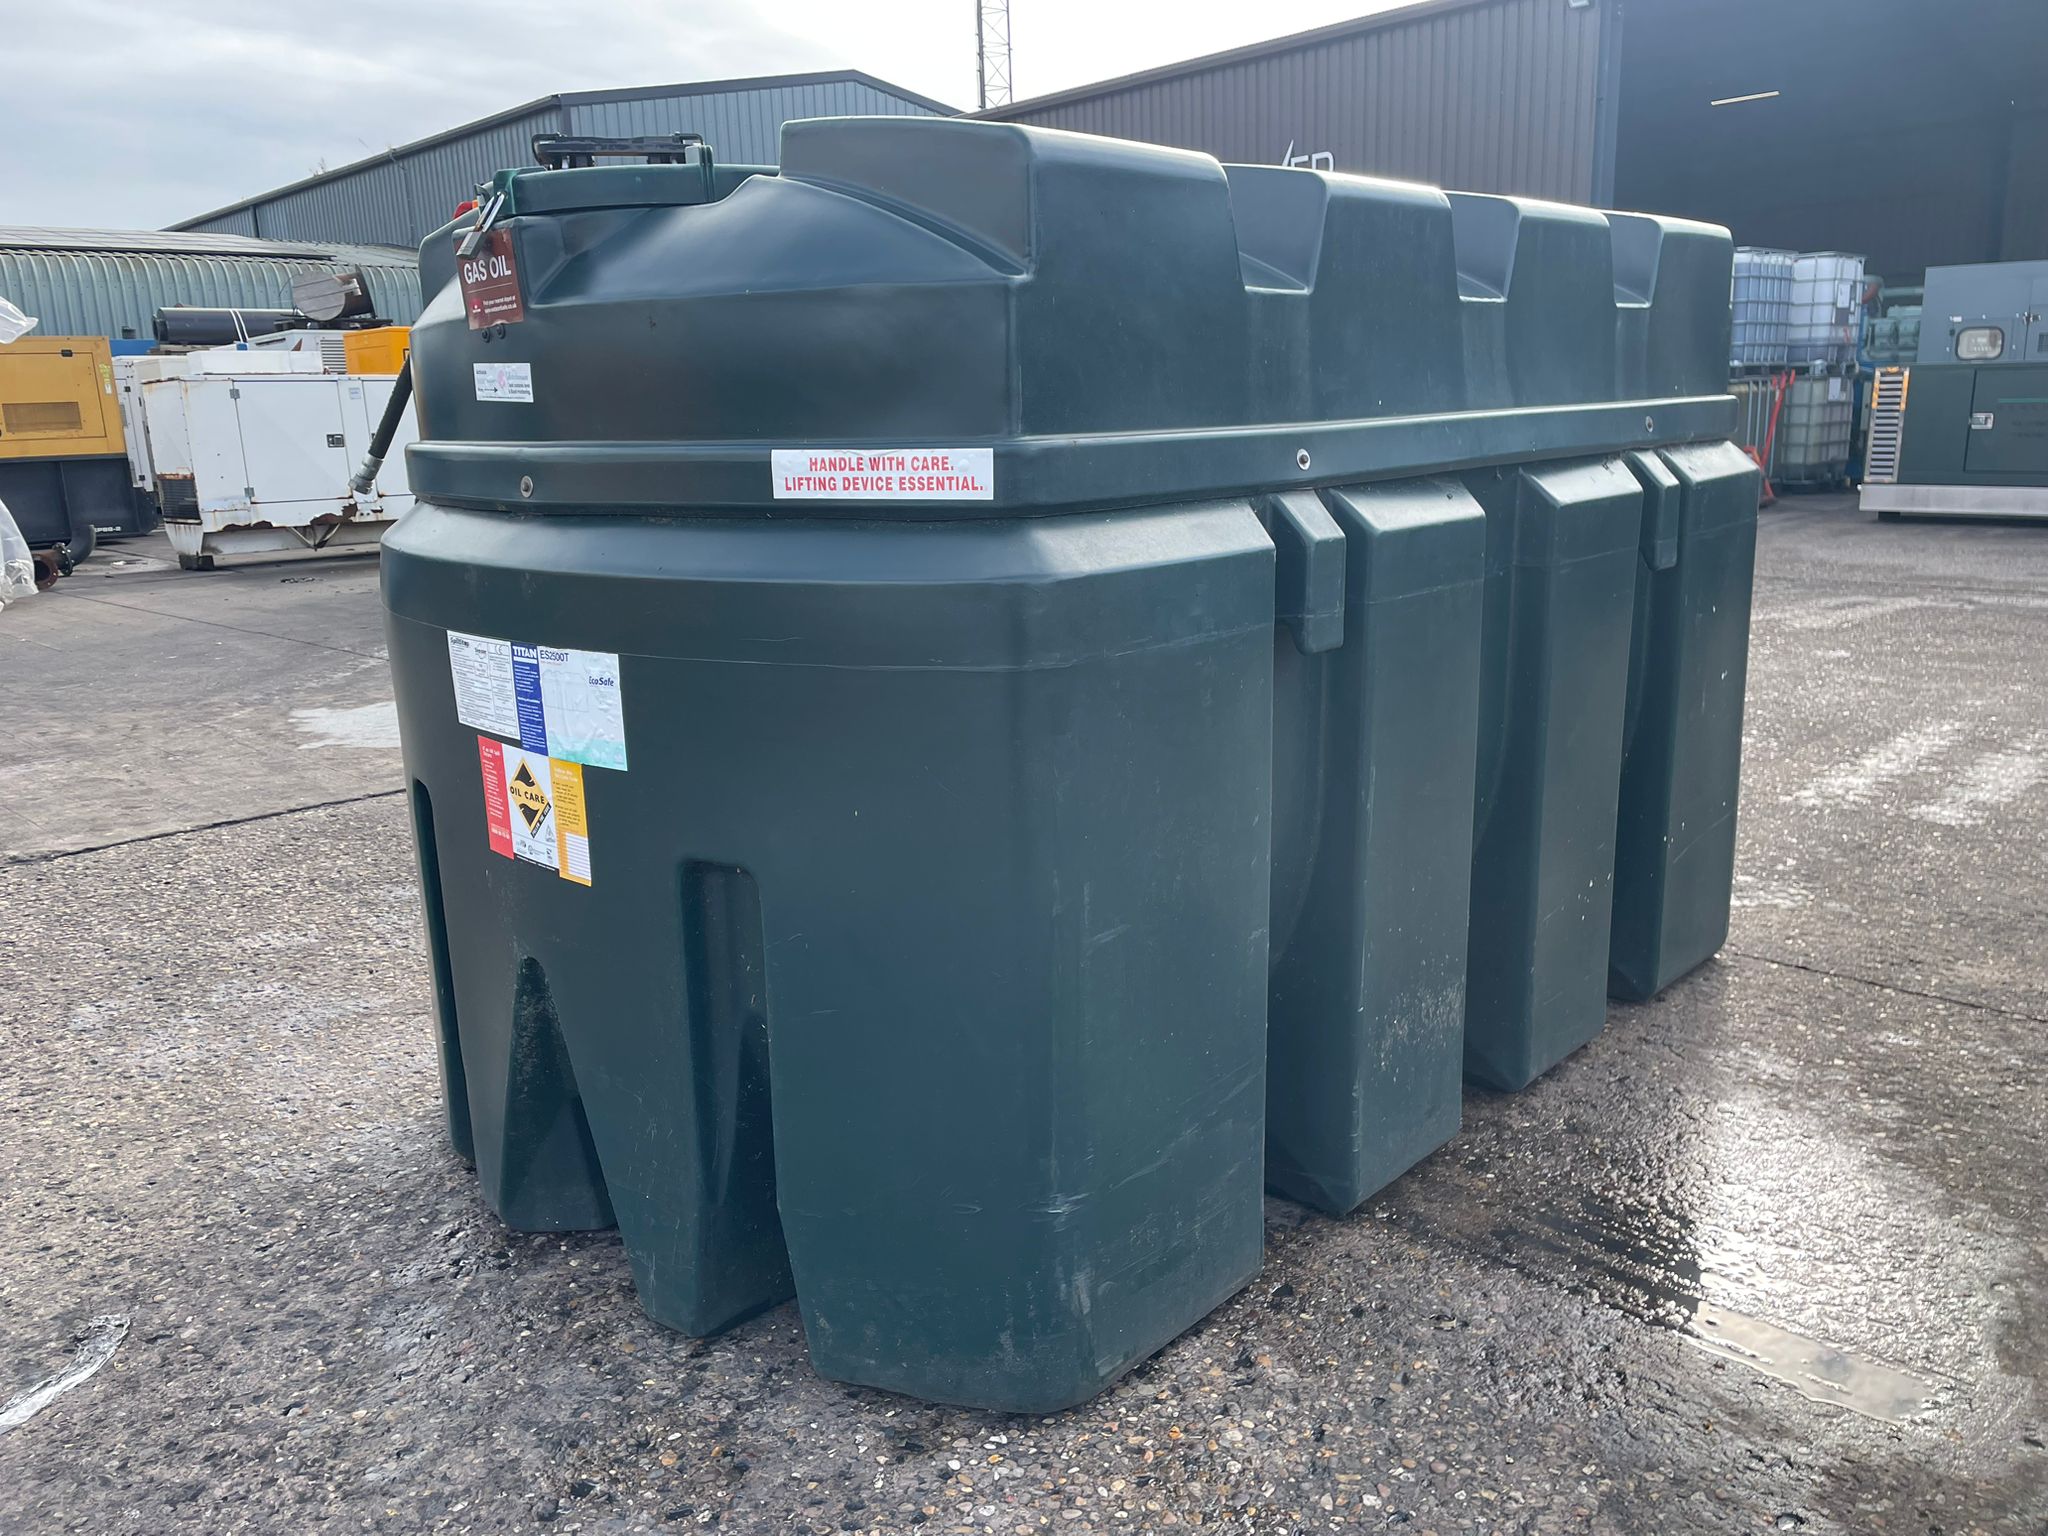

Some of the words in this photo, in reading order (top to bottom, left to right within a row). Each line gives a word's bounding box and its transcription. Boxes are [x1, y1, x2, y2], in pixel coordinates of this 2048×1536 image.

[464, 260, 487, 284] GAS
[489, 255, 512, 278] OIL
[809, 457, 864, 472] HANDLE
[869, 456, 905, 472] WITH
[911, 456, 954, 471] CARE.
[785, 477, 837, 491] LIFTING
[842, 477, 893, 491] DEVICE
[900, 476, 983, 491] ESSENTIAL.
[512, 645, 537, 659] TITAN
[540, 650, 569, 662] ES2500T
[509, 786, 522, 797] OIL
[524, 791, 545, 804] CARE
